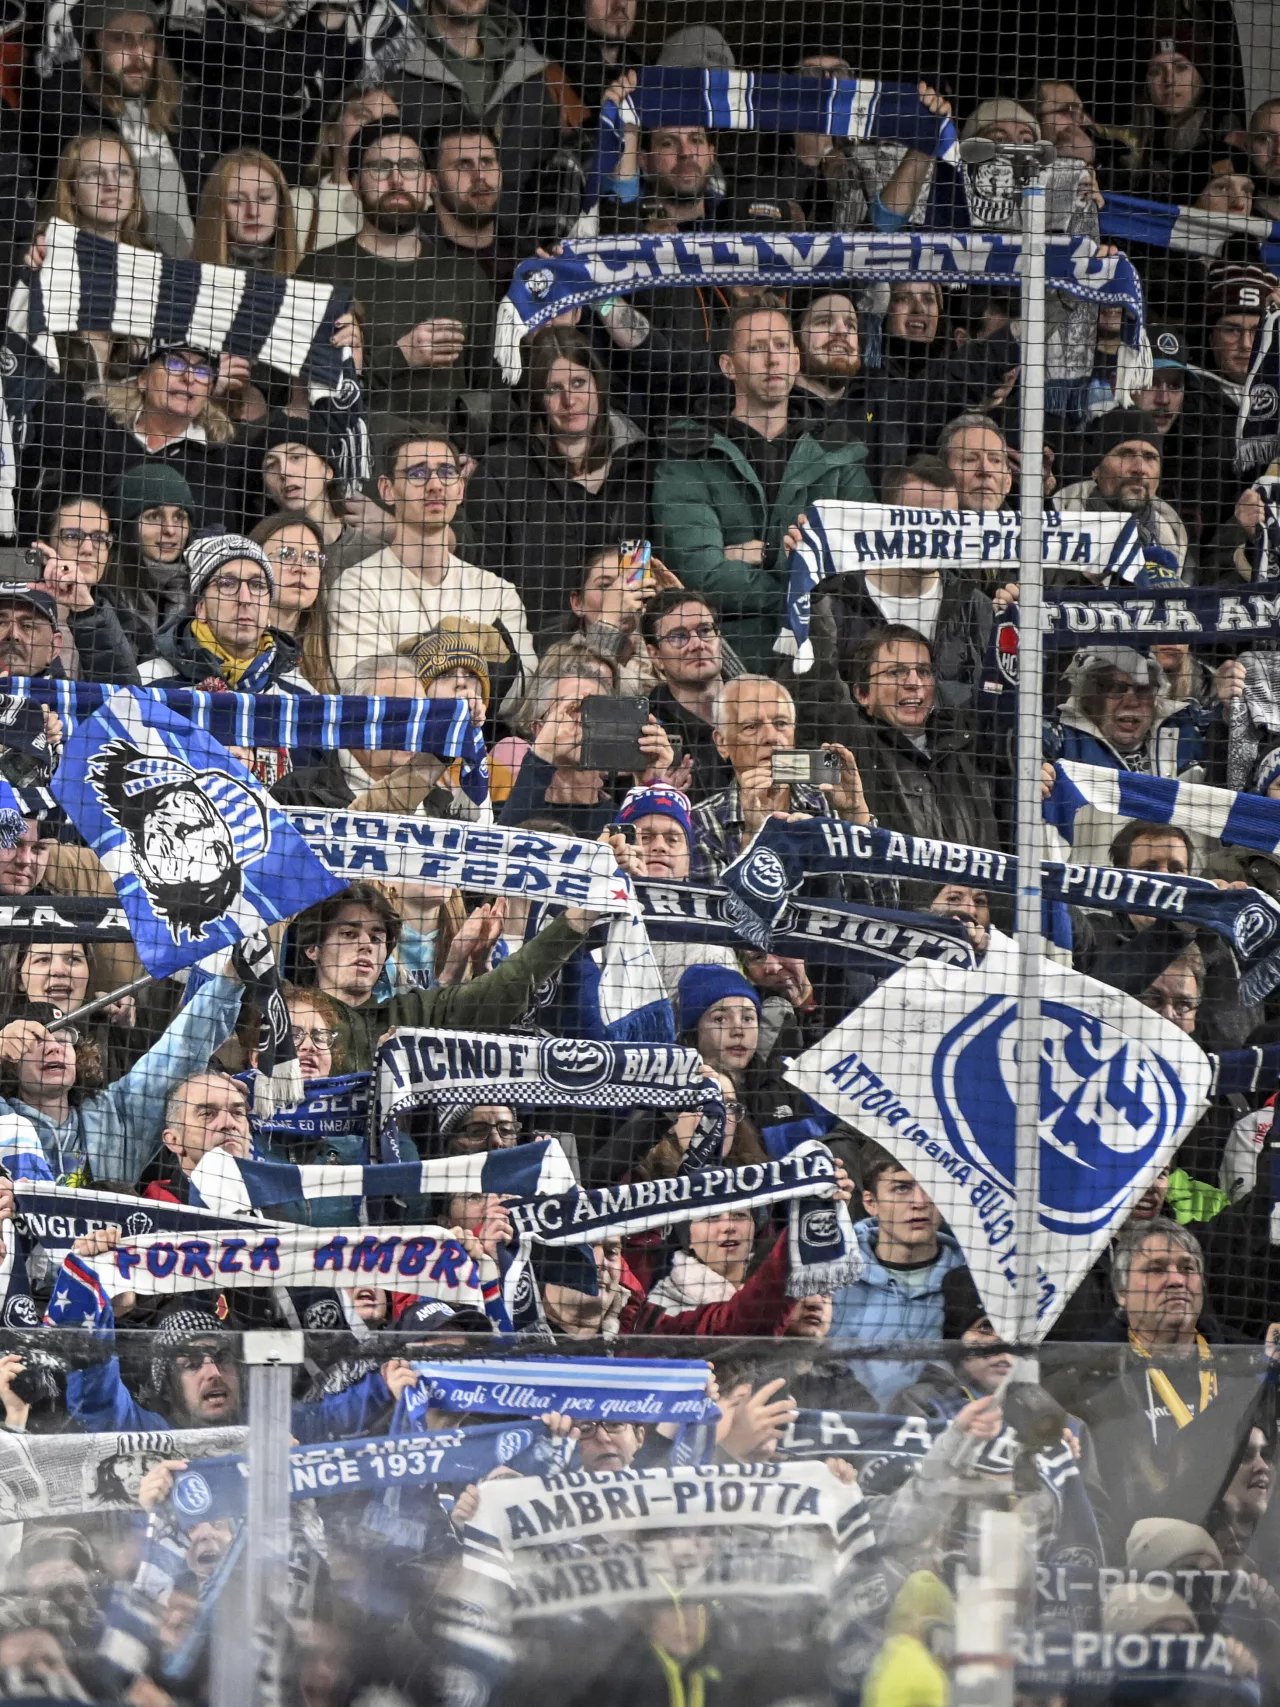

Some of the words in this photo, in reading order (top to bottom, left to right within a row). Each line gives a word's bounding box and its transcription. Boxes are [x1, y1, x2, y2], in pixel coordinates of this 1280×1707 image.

[1238, 287, 1261, 307] S
[853, 529, 1092, 564] AMBRI-PITTA
[1039, 599, 1203, 634] FORZA
[310, 843, 389, 872] NA
[419, 851, 593, 900] FEDE
[820, 822, 873, 858] HC
[885, 830, 1008, 882] AMBRI
[1060, 868, 1189, 914] PIOTTA
[620, 1047, 704, 1087] BIANC
[508, 1198, 563, 1238] HC
[571, 1151, 836, 1225] AMBRI-PIOTTA
[114, 1236, 282, 1281] FORZA
[449, 1384, 488, 1409] agli
[599, 1393, 664, 1418] questa
[369, 1450, 446, 1480] 1937
[504, 1480, 822, 1541] AMBRI-PIOTTA
[1034, 1566, 1258, 1609] RI-PIOTTA
